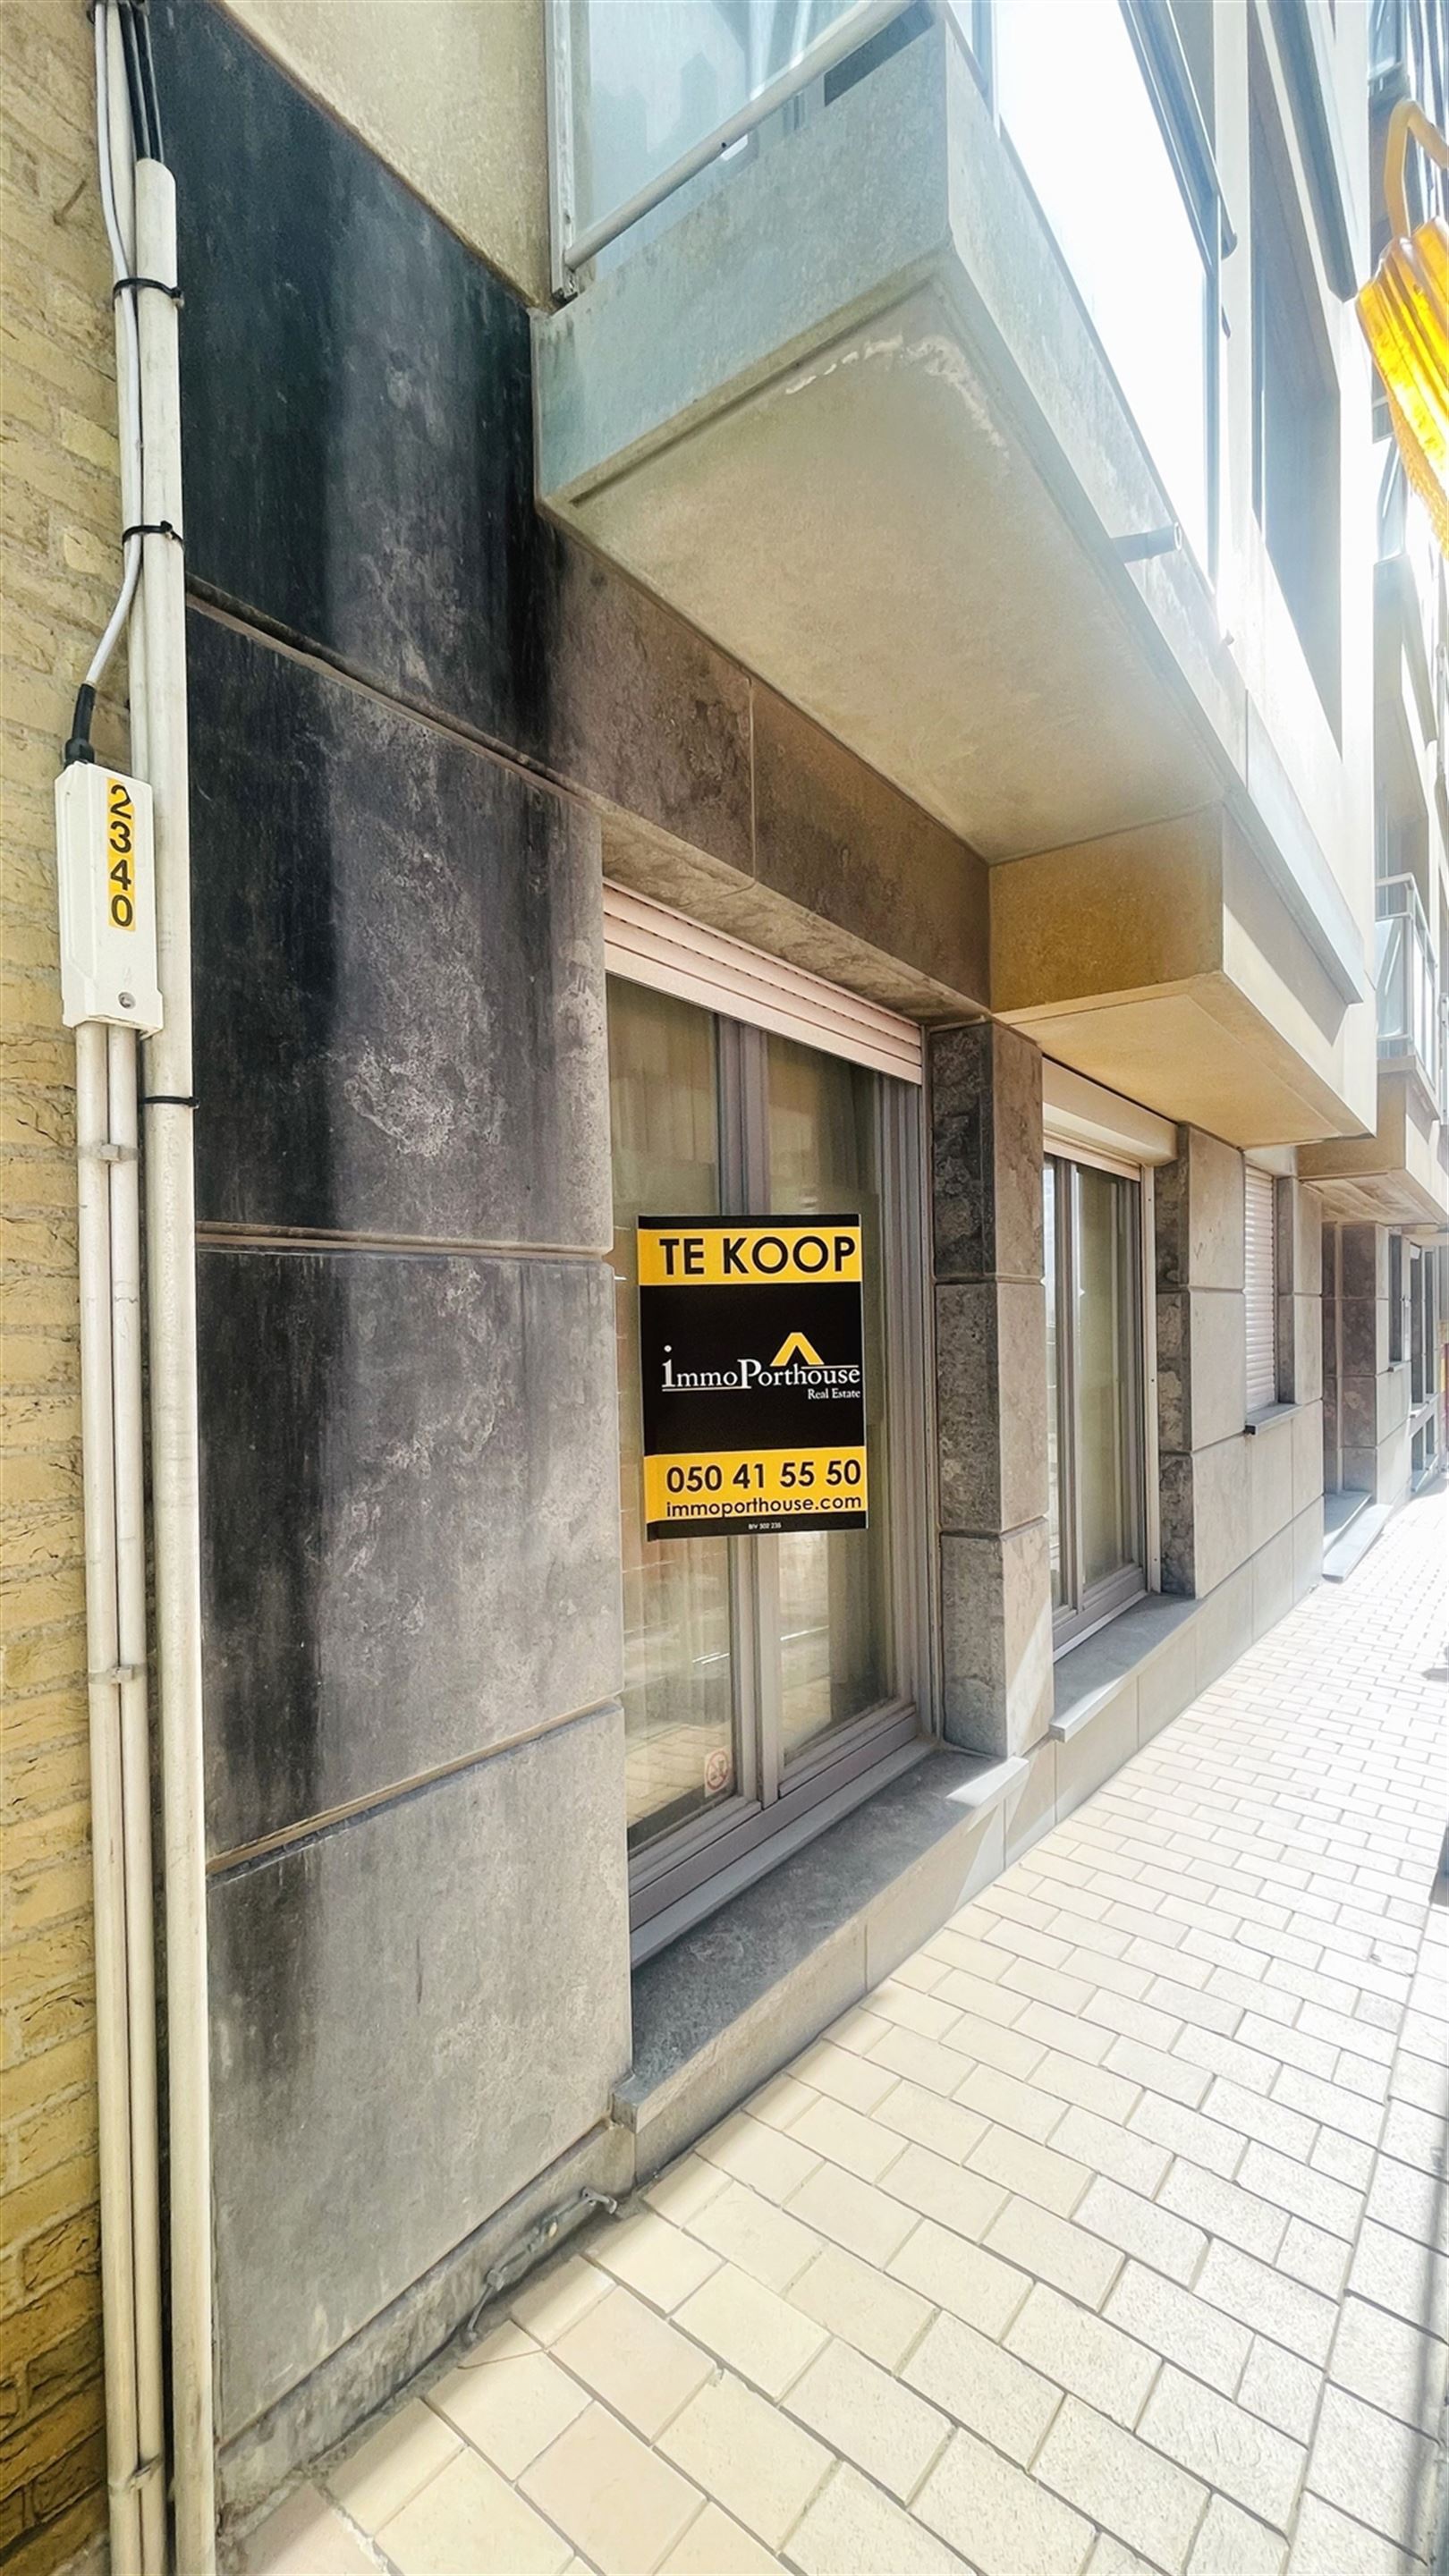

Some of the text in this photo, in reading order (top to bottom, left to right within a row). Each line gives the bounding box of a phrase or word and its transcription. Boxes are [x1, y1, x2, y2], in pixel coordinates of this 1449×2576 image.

[110, 784, 133, 928] 2340
[660, 1236, 855, 1275] TE KOOP
[808, 1388, 861, 1400] Real Estate
[666, 1459, 861, 1493] 050 41 55 50
[666, 1496, 861, 1518] immoporthouse.com
